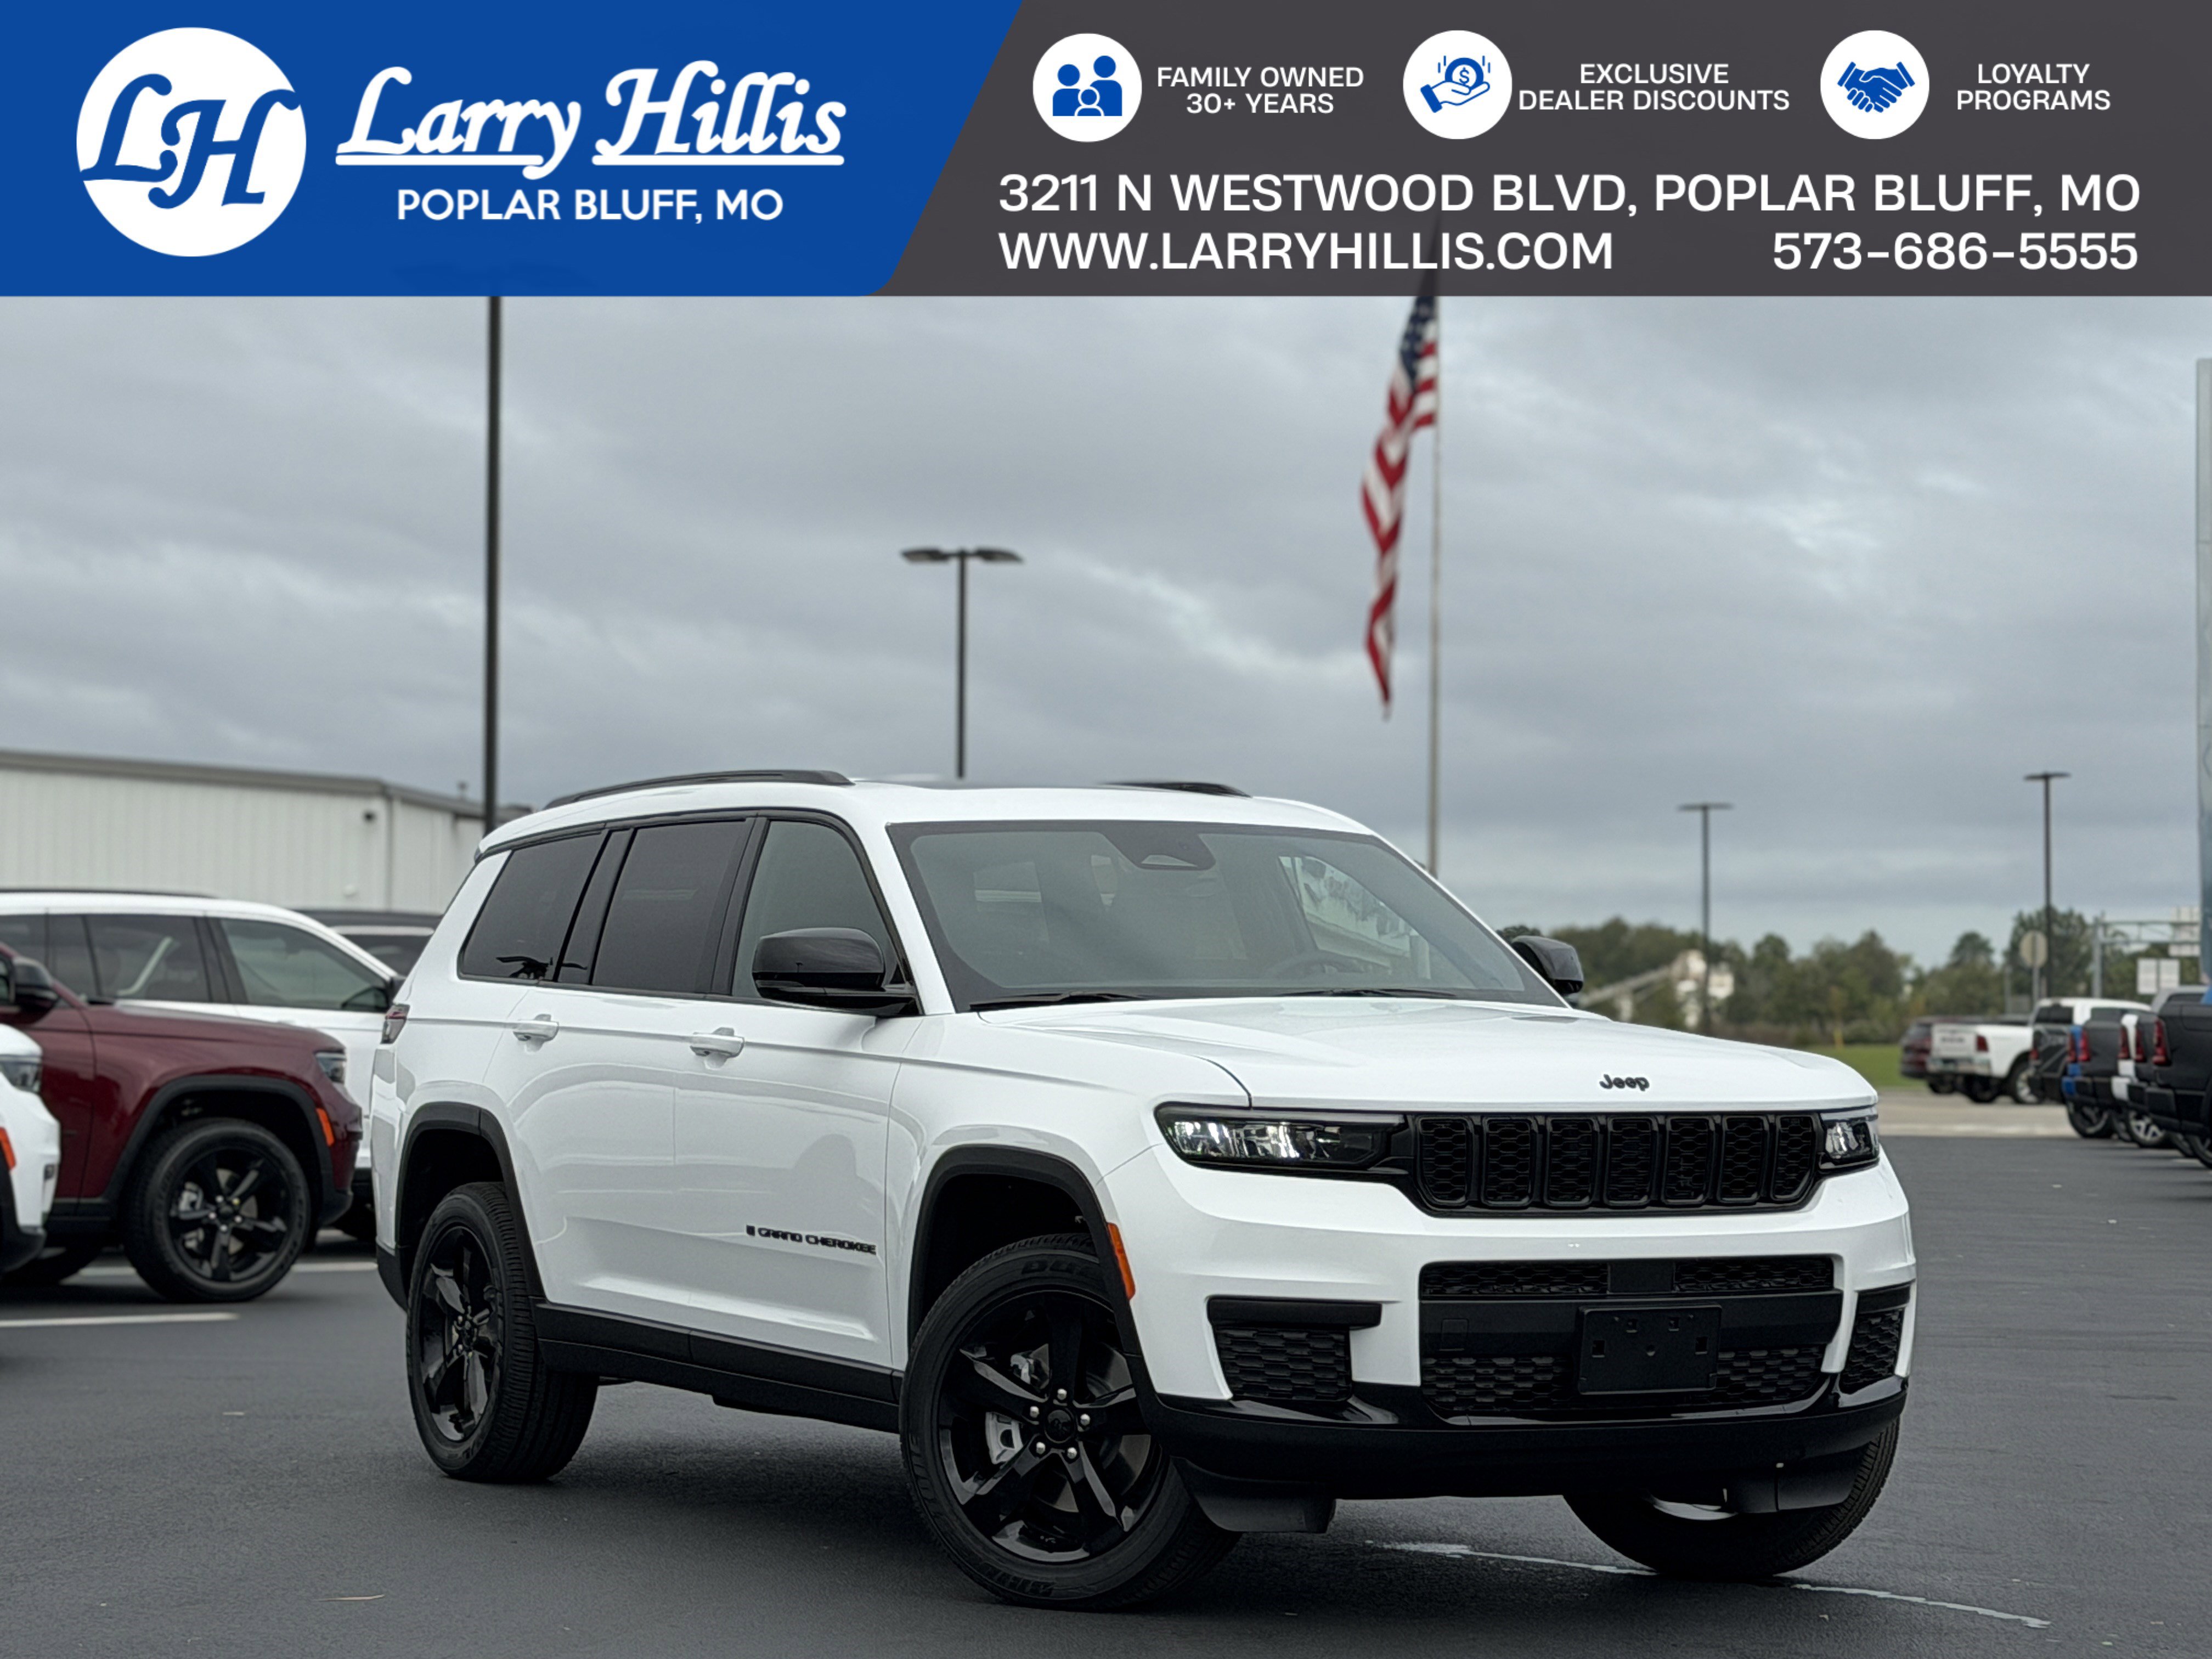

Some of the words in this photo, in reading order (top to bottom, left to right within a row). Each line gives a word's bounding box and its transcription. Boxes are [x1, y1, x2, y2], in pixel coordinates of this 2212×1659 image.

[1599, 1074, 1650, 1092] Jeep
[757, 1227, 803, 1243] GRAND
[805, 1234, 877, 1256] CHEROKEE
